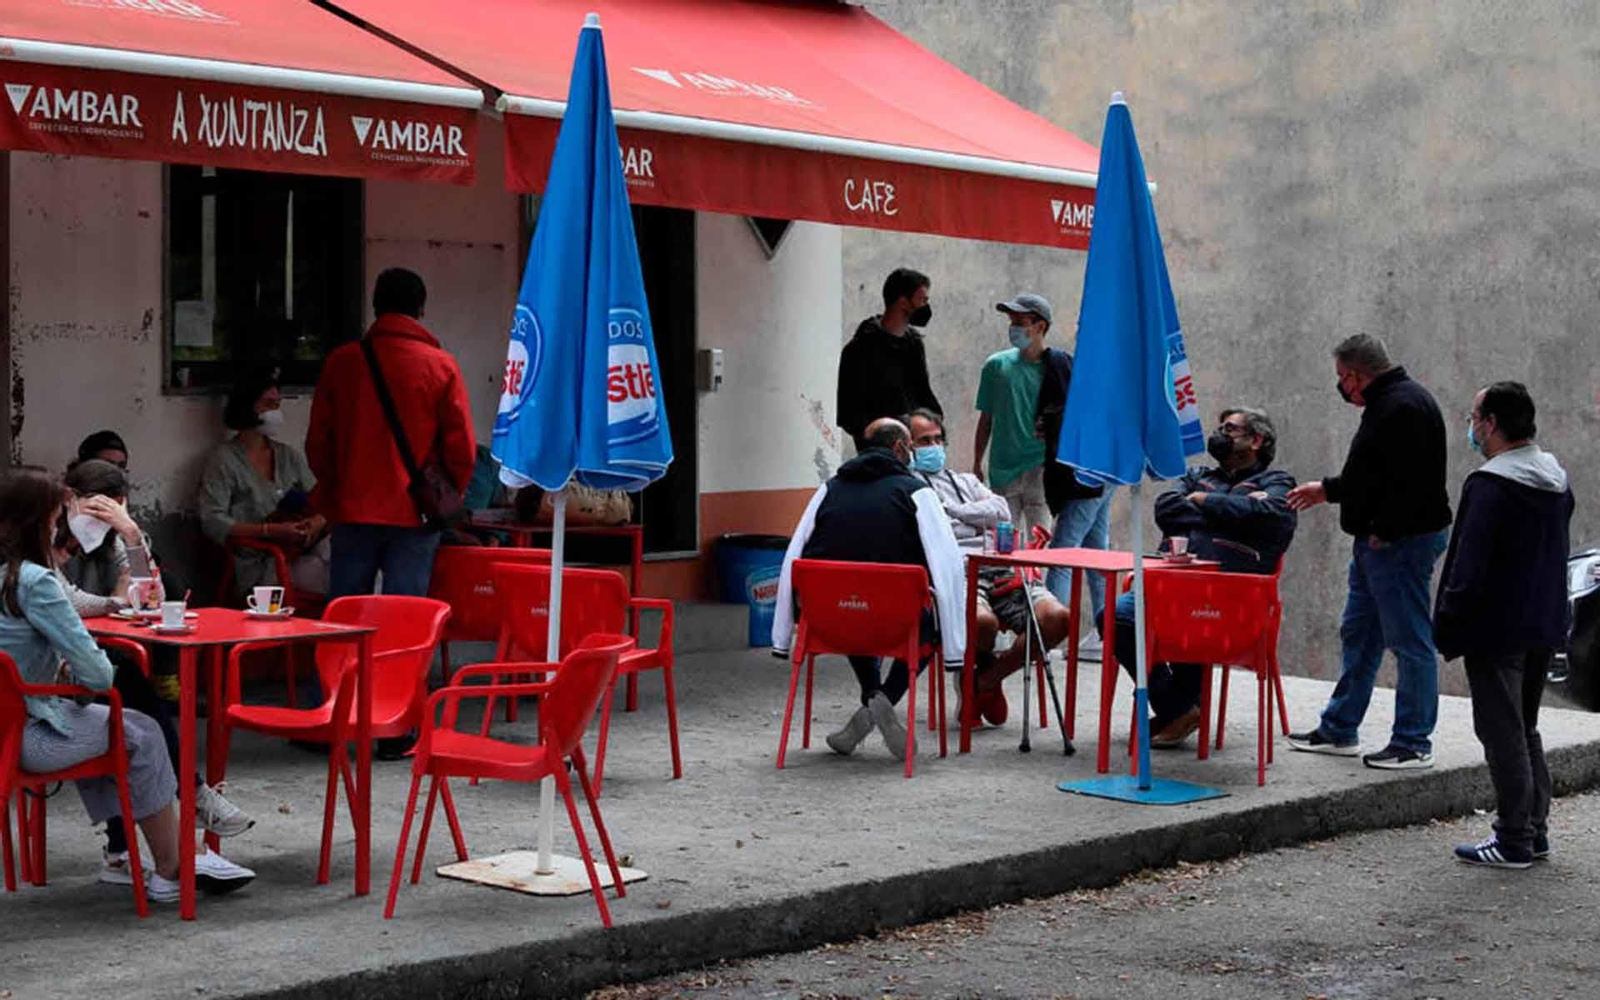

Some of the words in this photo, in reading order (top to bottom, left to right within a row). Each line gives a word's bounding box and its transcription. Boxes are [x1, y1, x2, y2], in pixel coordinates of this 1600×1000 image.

[29, 86, 143, 128] AMBAR
[172, 90, 188, 144] A
[198, 93, 327, 157] XUNTANZA
[372, 119, 468, 156] AMBAR
